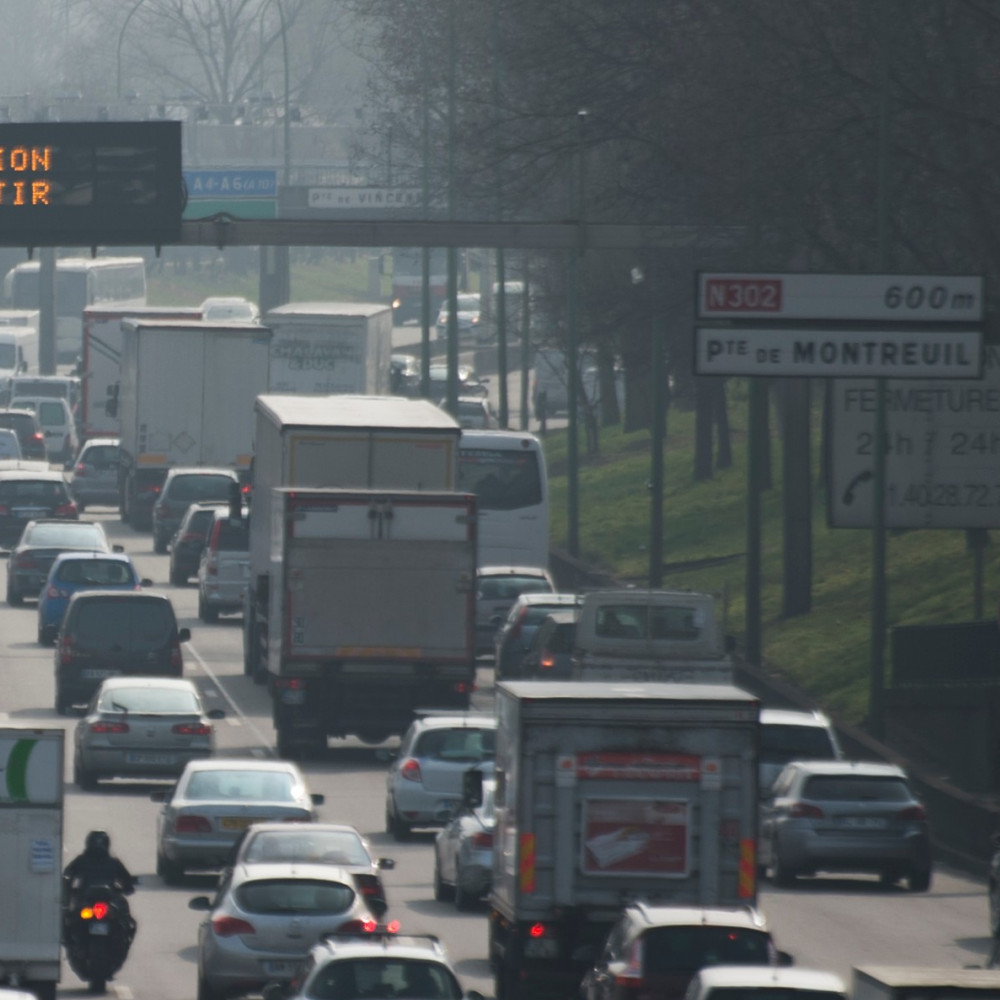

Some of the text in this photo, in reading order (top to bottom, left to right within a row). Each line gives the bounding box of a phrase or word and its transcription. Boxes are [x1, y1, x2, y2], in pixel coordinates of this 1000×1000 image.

[708, 284, 779, 308] N302
[756, 348, 782, 364] DE
[792, 341, 972, 366] MONTREUIL
